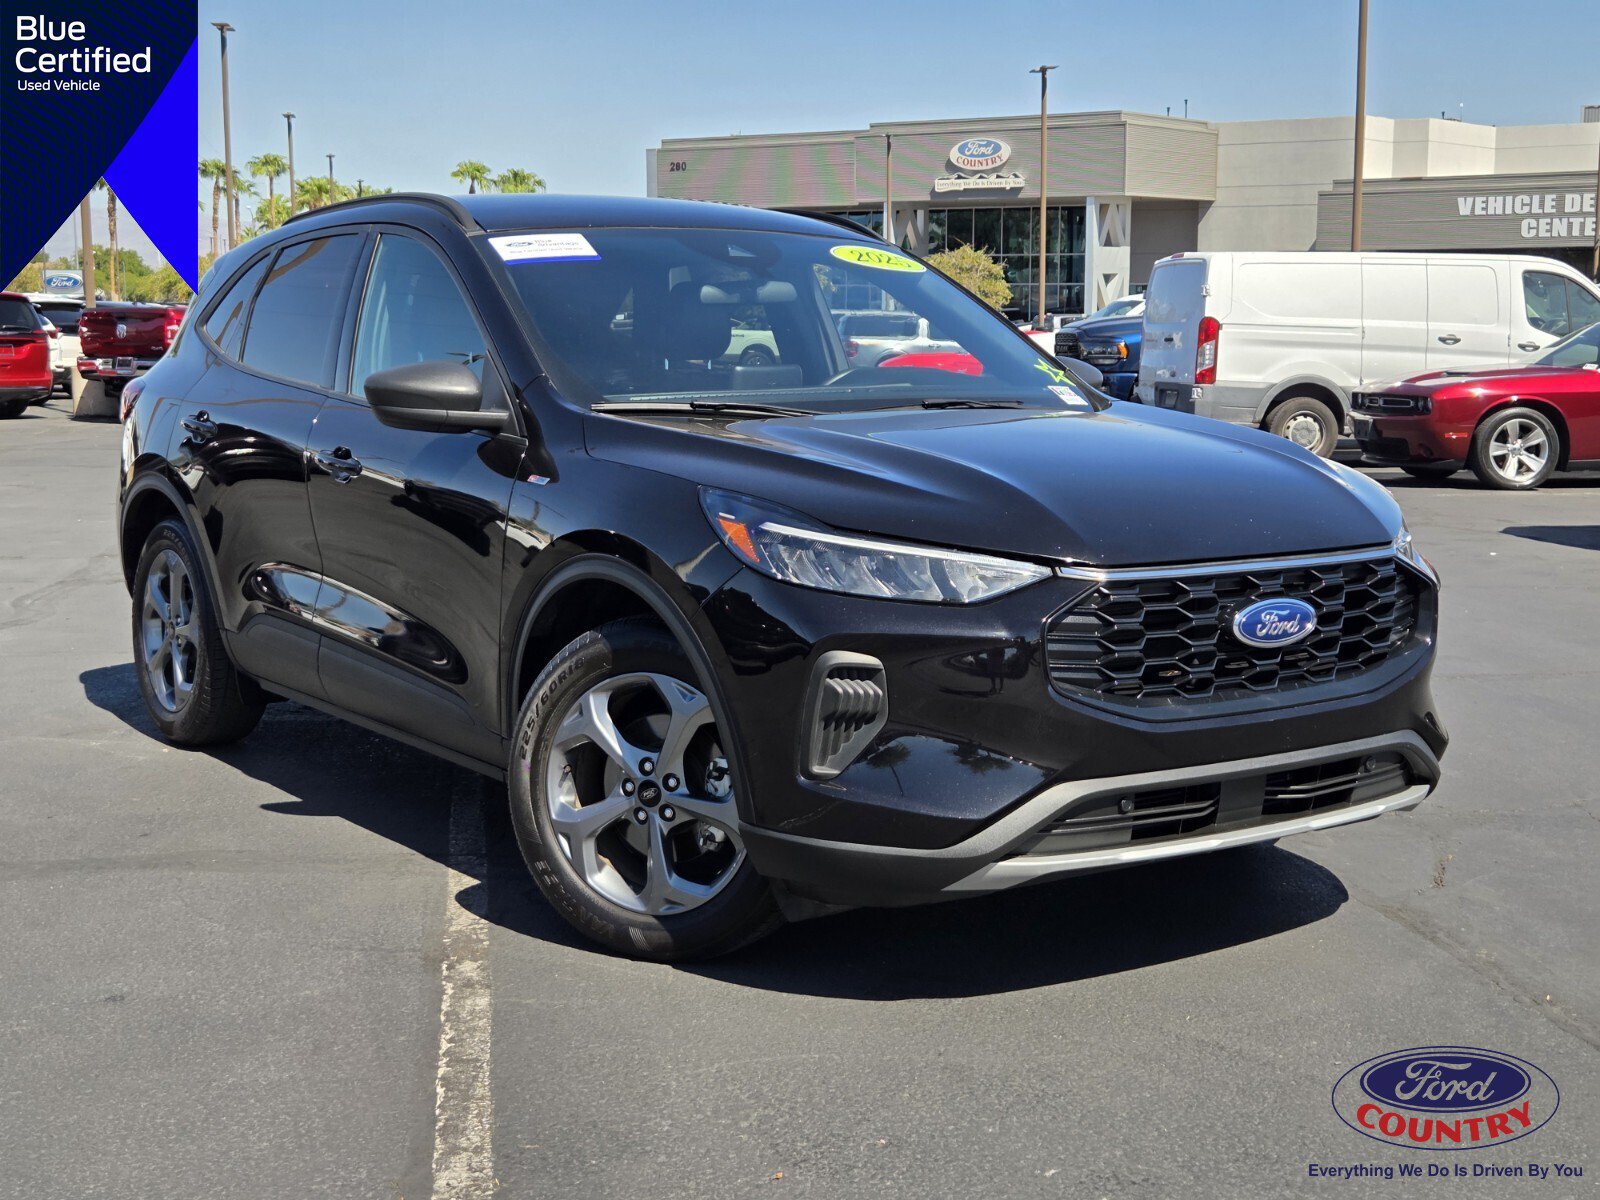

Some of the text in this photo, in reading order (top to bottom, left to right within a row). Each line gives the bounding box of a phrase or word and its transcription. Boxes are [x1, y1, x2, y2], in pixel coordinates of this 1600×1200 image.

[964, 140, 995, 155] Ford
[669, 161, 687, 172] 280
[956, 153, 1004, 167] COUNTRY
[1457, 194, 1557, 216] VEHICLE
[50, 276, 75, 287] Ford
[1256, 609, 1301, 637] Ford
